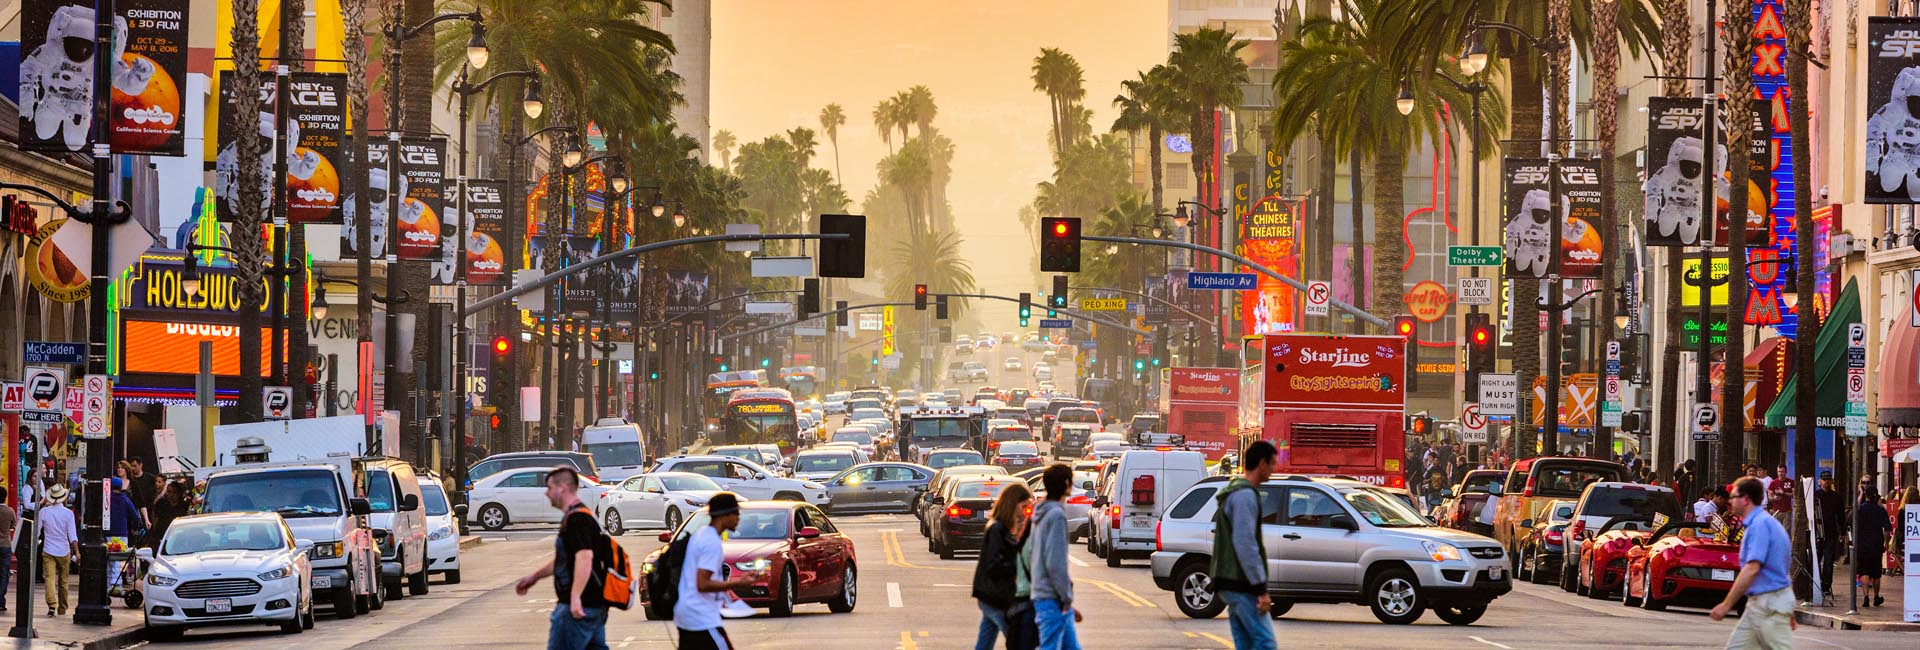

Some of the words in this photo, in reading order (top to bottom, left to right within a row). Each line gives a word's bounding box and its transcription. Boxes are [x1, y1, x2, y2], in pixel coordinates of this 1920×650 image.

[127, 9, 181, 20] EXHIBITION
[129, 20, 136, 29] &
[138, 19, 154, 29] 3D
[156, 21, 180, 30] FILM
[136, 37, 152, 45] OCT
[1752, 0, 1785, 77] AX
[160, 45, 178, 53] 2016
[299, 114, 340, 122] EXHIBITION
[1657, 116, 1764, 131] SPAE
[116, 126, 142, 134] California
[1513, 172, 1599, 184] SPACE
[1263, 201, 1278, 212] TCL
[1253, 213, 1288, 225] CHINESE
[1250, 226, 1292, 238] THEATRES
[1457, 249, 1482, 257] Dolby
[1452, 256, 1486, 264] Theatre
[1711, 263, 1728, 272] ESSIO
[1194, 275, 1235, 287] Highland
[1239, 276, 1251, 286] Av
[1462, 280, 1472, 288] DO
[1474, 280, 1488, 288] NOT
[38, 281, 66, 300] Since
[70, 284, 91, 300] 1989
[1464, 289, 1485, 297] BLOCK
[1402, 290, 1428, 304] ard
[1429, 289, 1457, 307] Roc
[1307, 305, 1315, 313] ON
[1316, 306, 1327, 314] RED
[884, 310, 893, 350] INN
[26, 343, 75, 355] McCadden
[1416, 363, 1437, 373] ATURE
[5, 387, 24, 402] AT
[67, 388, 83, 402] AT
[737, 405, 752, 413] 780
[1816, 416, 1846, 427] GALORE
[1907, 512, 1920, 523] PU
[1907, 526, 1920, 537] PA
